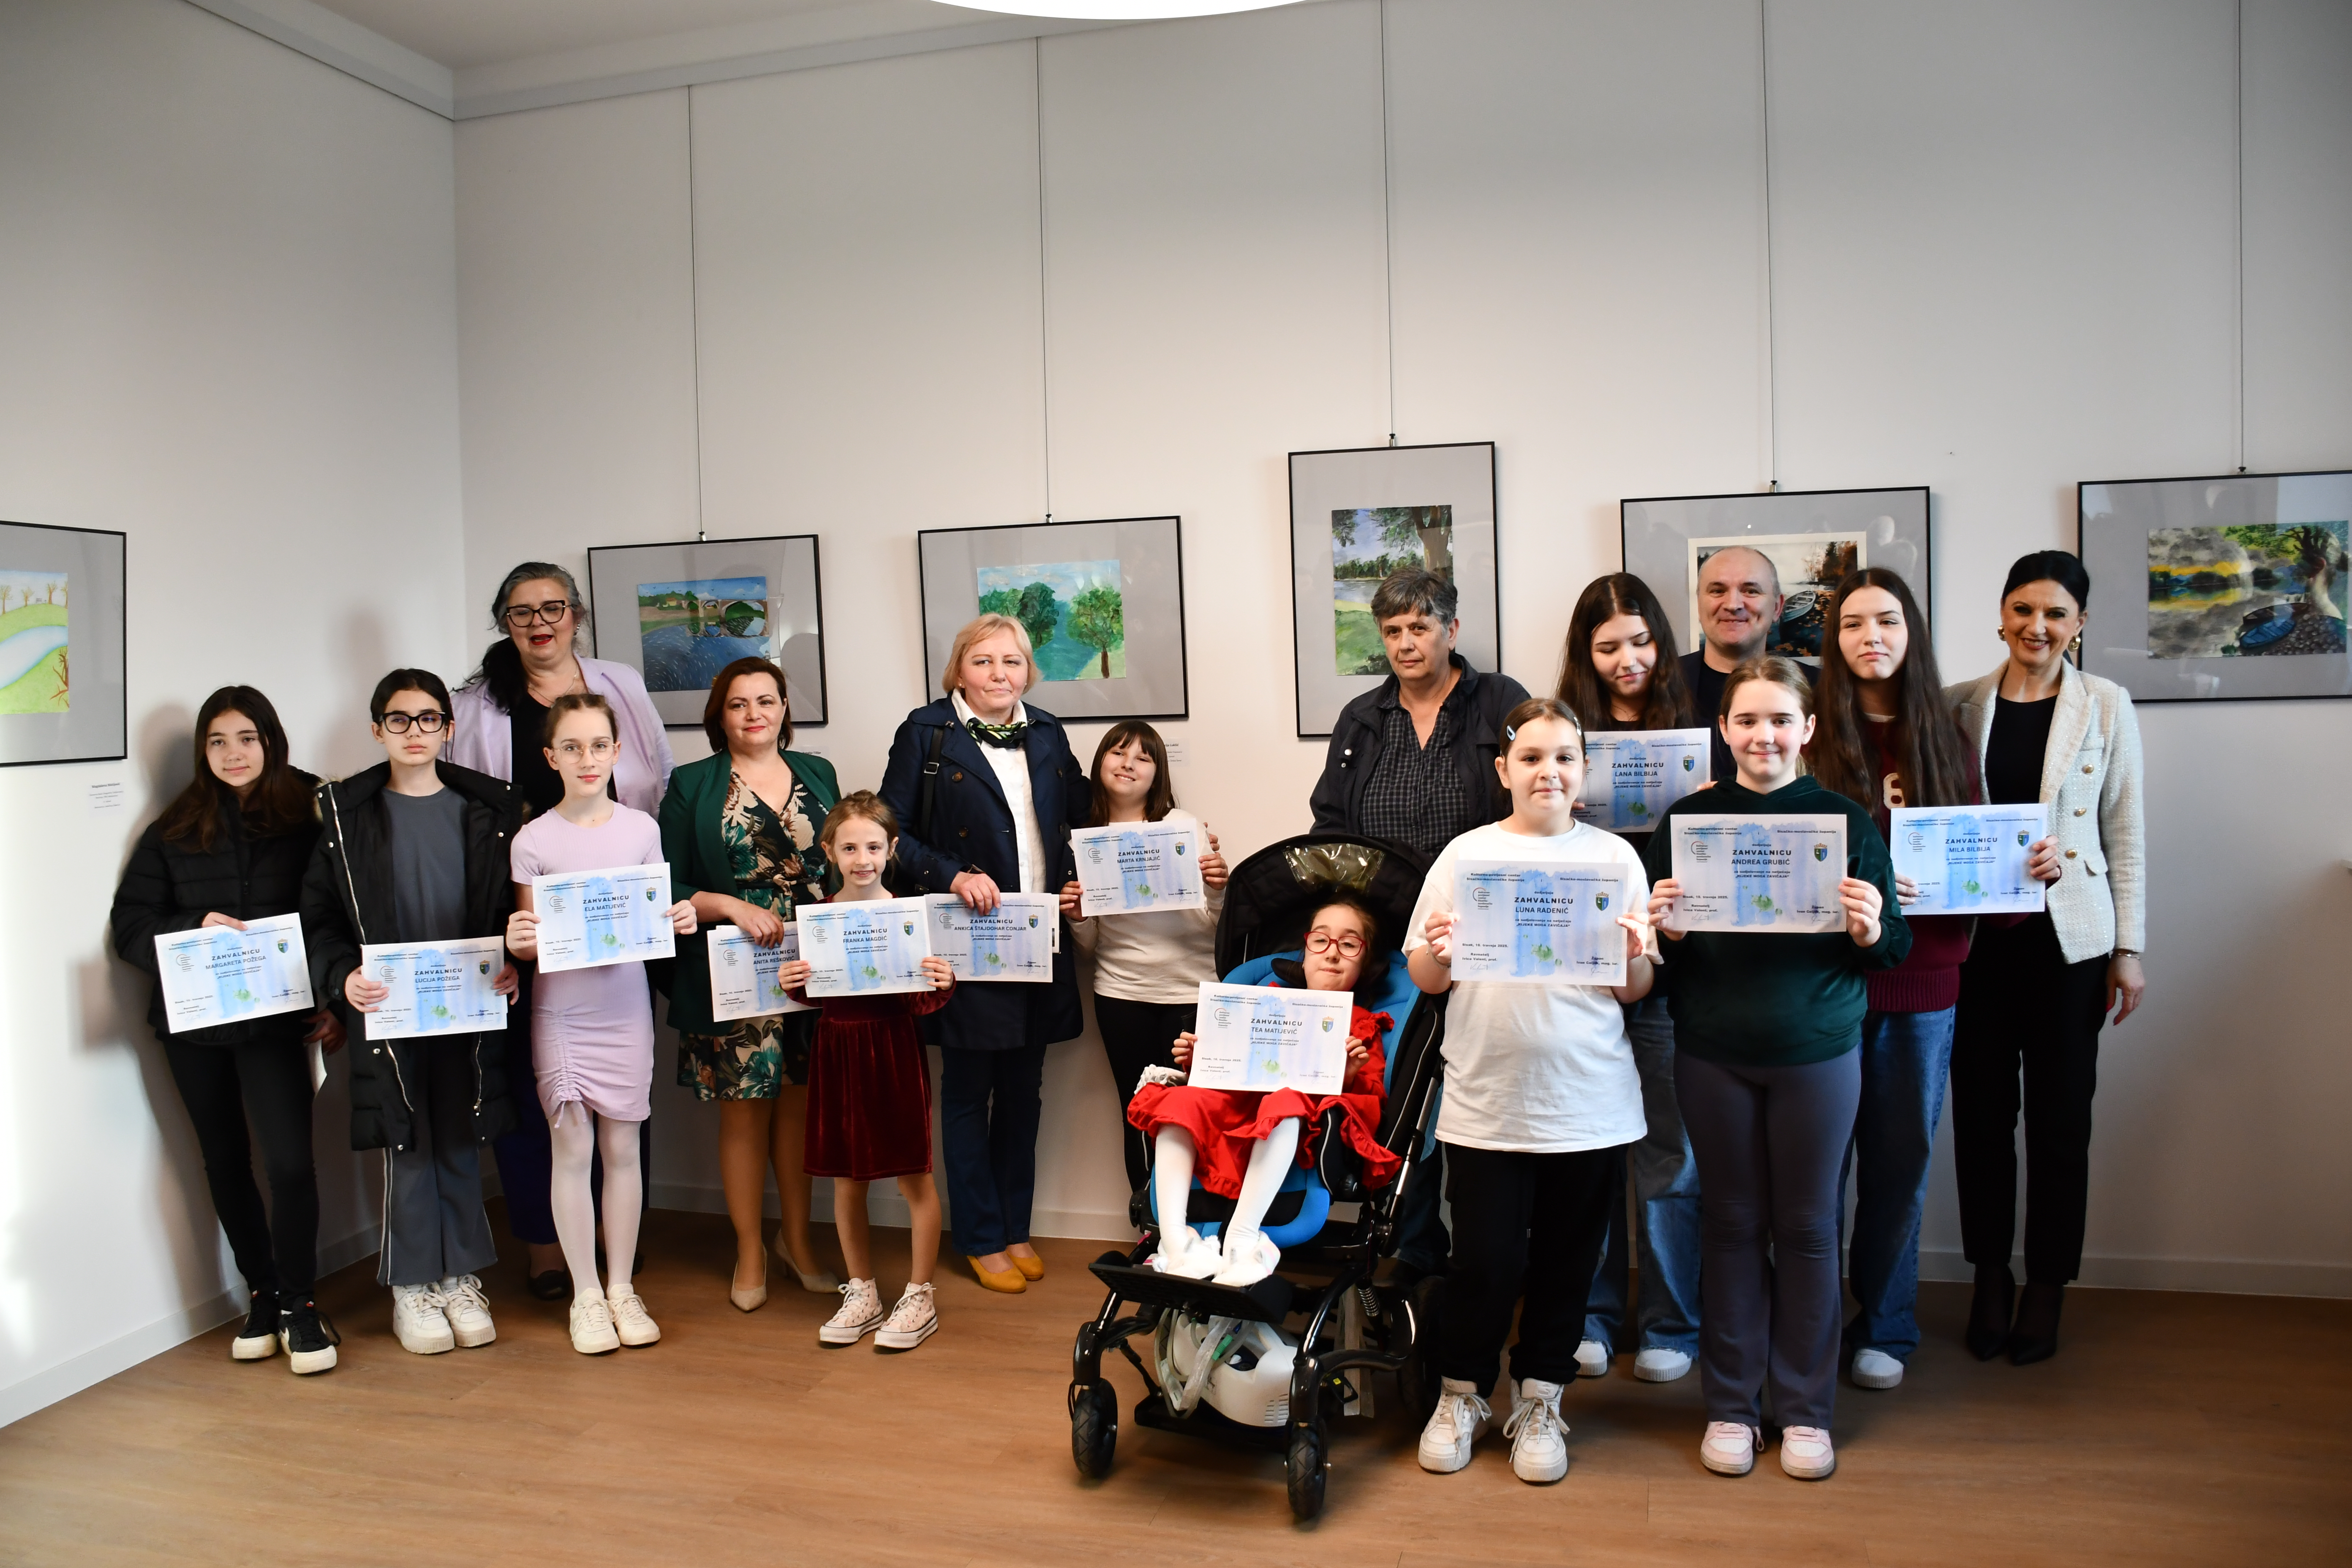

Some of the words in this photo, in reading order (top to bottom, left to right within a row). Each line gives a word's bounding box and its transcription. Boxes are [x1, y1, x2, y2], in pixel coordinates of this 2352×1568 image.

[583, 895, 629, 904] ZAHVALNICU
[596, 902, 626, 910] MATIJEVIĆ
[211, 948, 260, 961] ZAHVALNICU
[754, 948, 795, 957] ZAHVALNICU
[205, 959, 241, 969] MARGARETA
[242, 954, 266, 963] POŽEGA
[1250, 1018, 1302, 1026] ZAHVALNICU
[1264, 1026, 1297, 1034] MATIJEVIĆ
